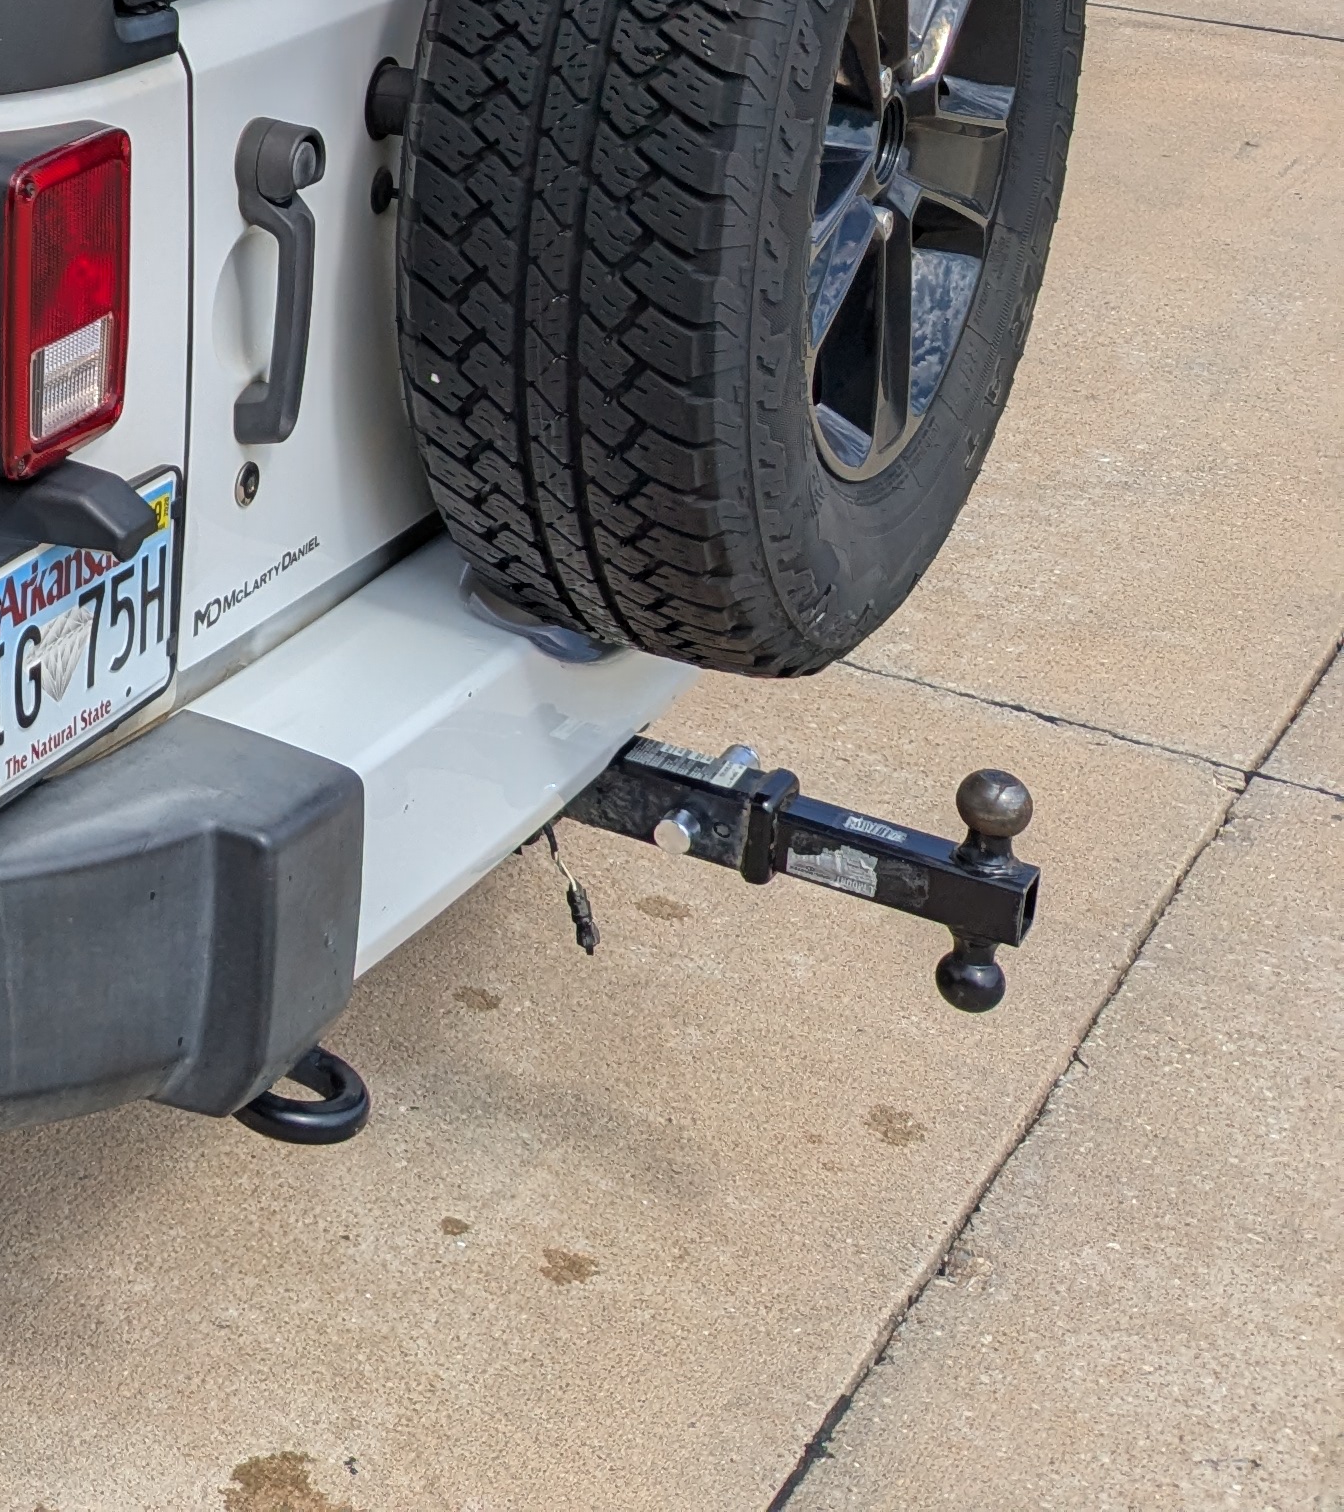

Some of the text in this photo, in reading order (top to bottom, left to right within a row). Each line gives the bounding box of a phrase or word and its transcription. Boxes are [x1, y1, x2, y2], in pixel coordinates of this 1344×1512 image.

[78, 543, 167, 689] 75H
[5, 698, 112, 780] The Natural State
